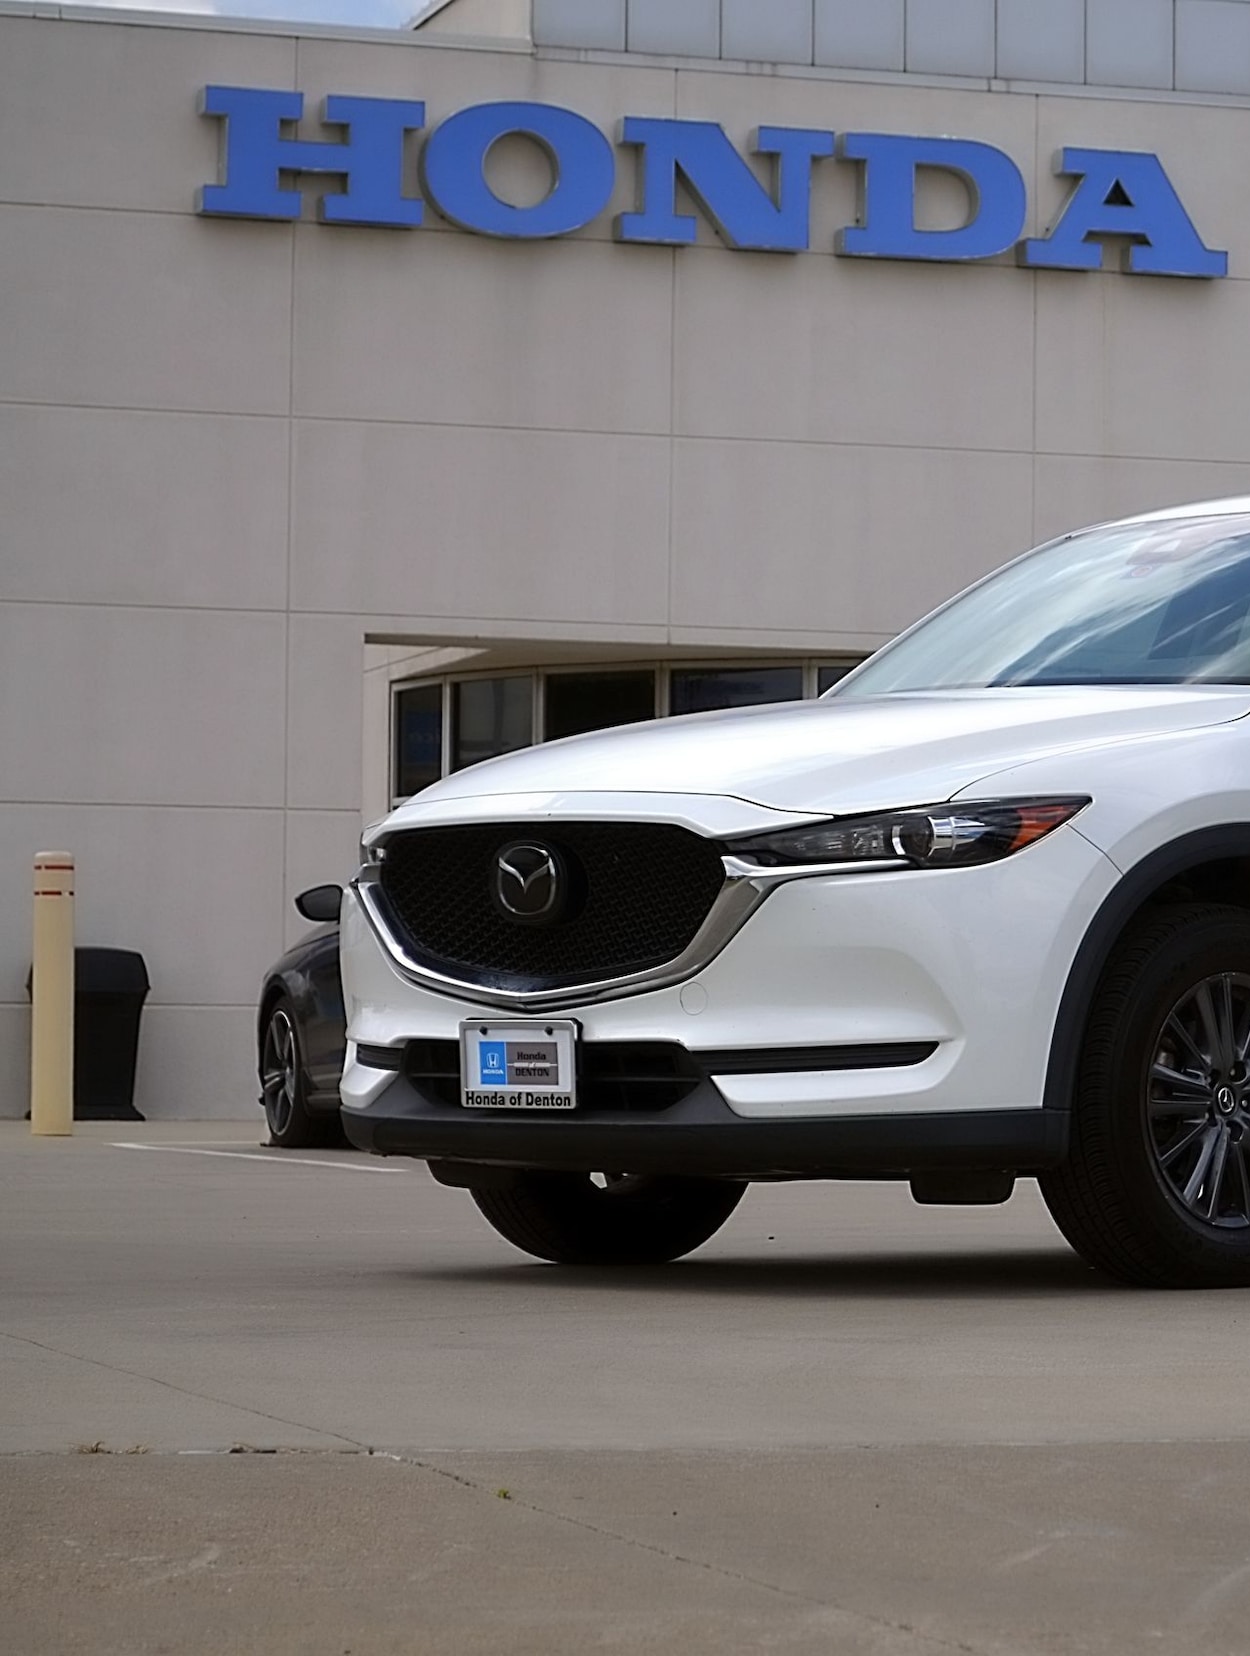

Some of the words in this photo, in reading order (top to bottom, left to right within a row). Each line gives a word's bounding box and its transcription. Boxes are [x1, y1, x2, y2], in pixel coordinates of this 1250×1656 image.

[198, 84, 1229, 279] HONDA
[517, 1051, 546, 1060] Honda
[515, 1068, 549, 1077] DENTON
[465, 1091, 505, 1106] Honda
[509, 1091, 522, 1106] of
[526, 1092, 571, 1107] Denton
